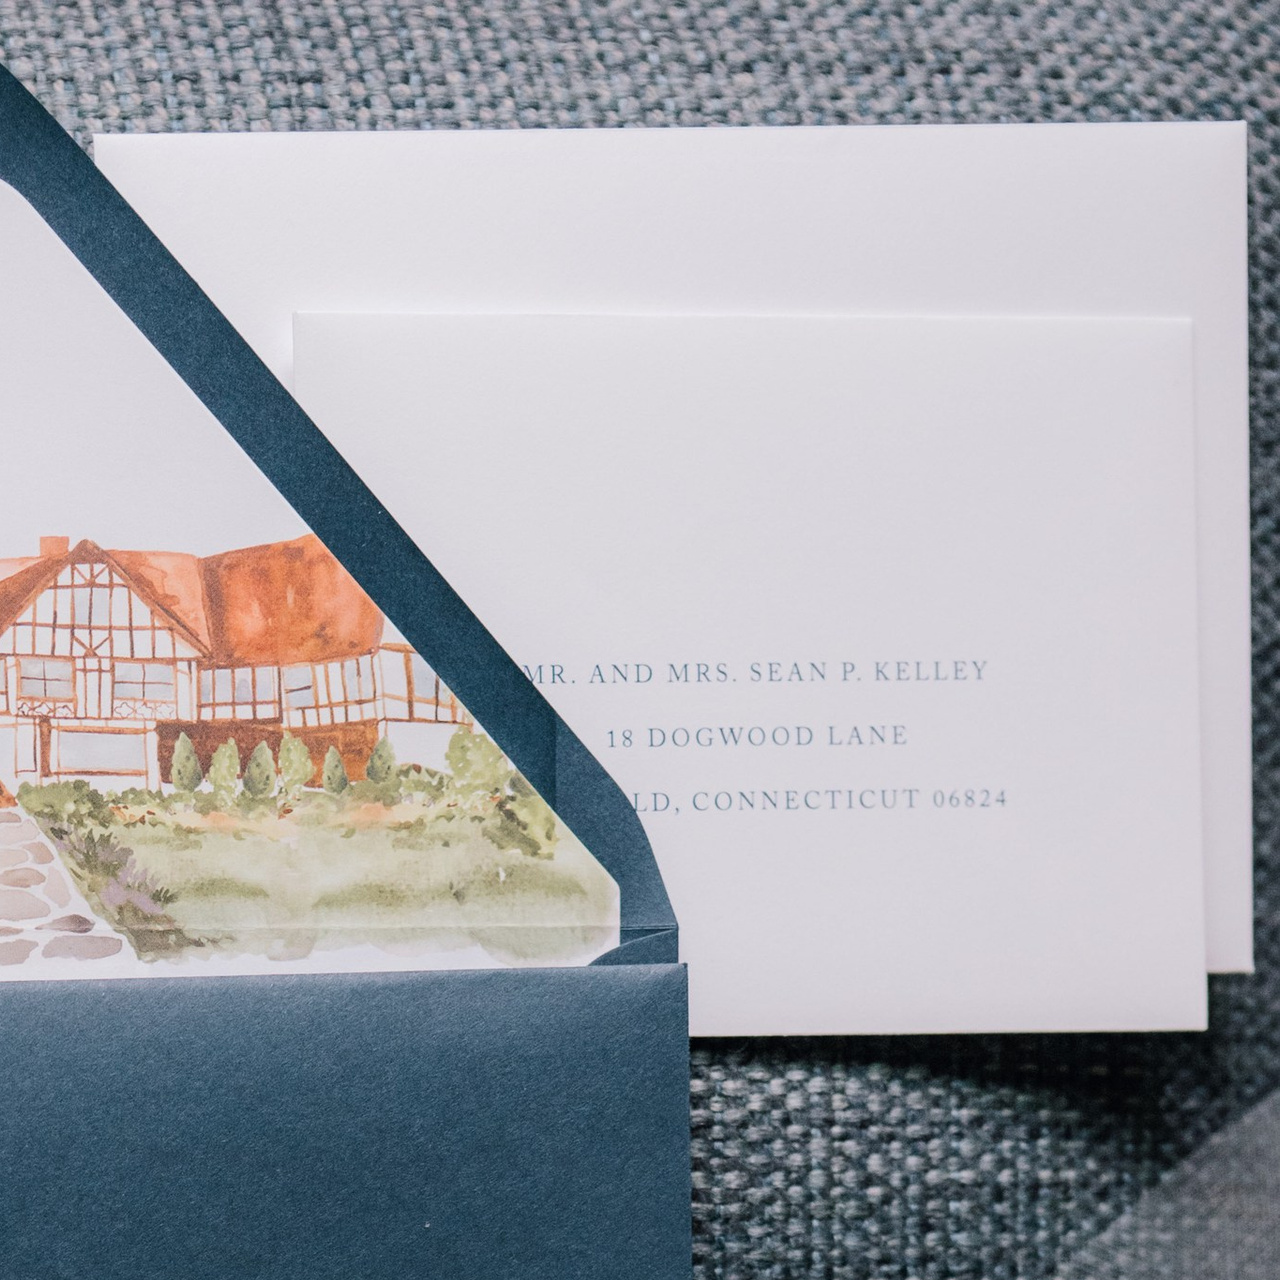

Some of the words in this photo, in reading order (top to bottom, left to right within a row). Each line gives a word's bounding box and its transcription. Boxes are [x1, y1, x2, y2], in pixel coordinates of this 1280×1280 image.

[524, 664, 576, 685] MR.
[588, 663, 653, 684] AND
[667, 662, 737, 683] MRS.
[750, 661, 827, 683] SEAN
[841, 661, 862, 682] P.
[874, 660, 988, 682] KELLEY
[607, 728, 633, 748] 18
[647, 726, 814, 748] DOGWOOD
[828, 724, 907, 746] LANE
[691, 788, 920, 812] CONNECTICUT
[932, 788, 1007, 809] 06824
